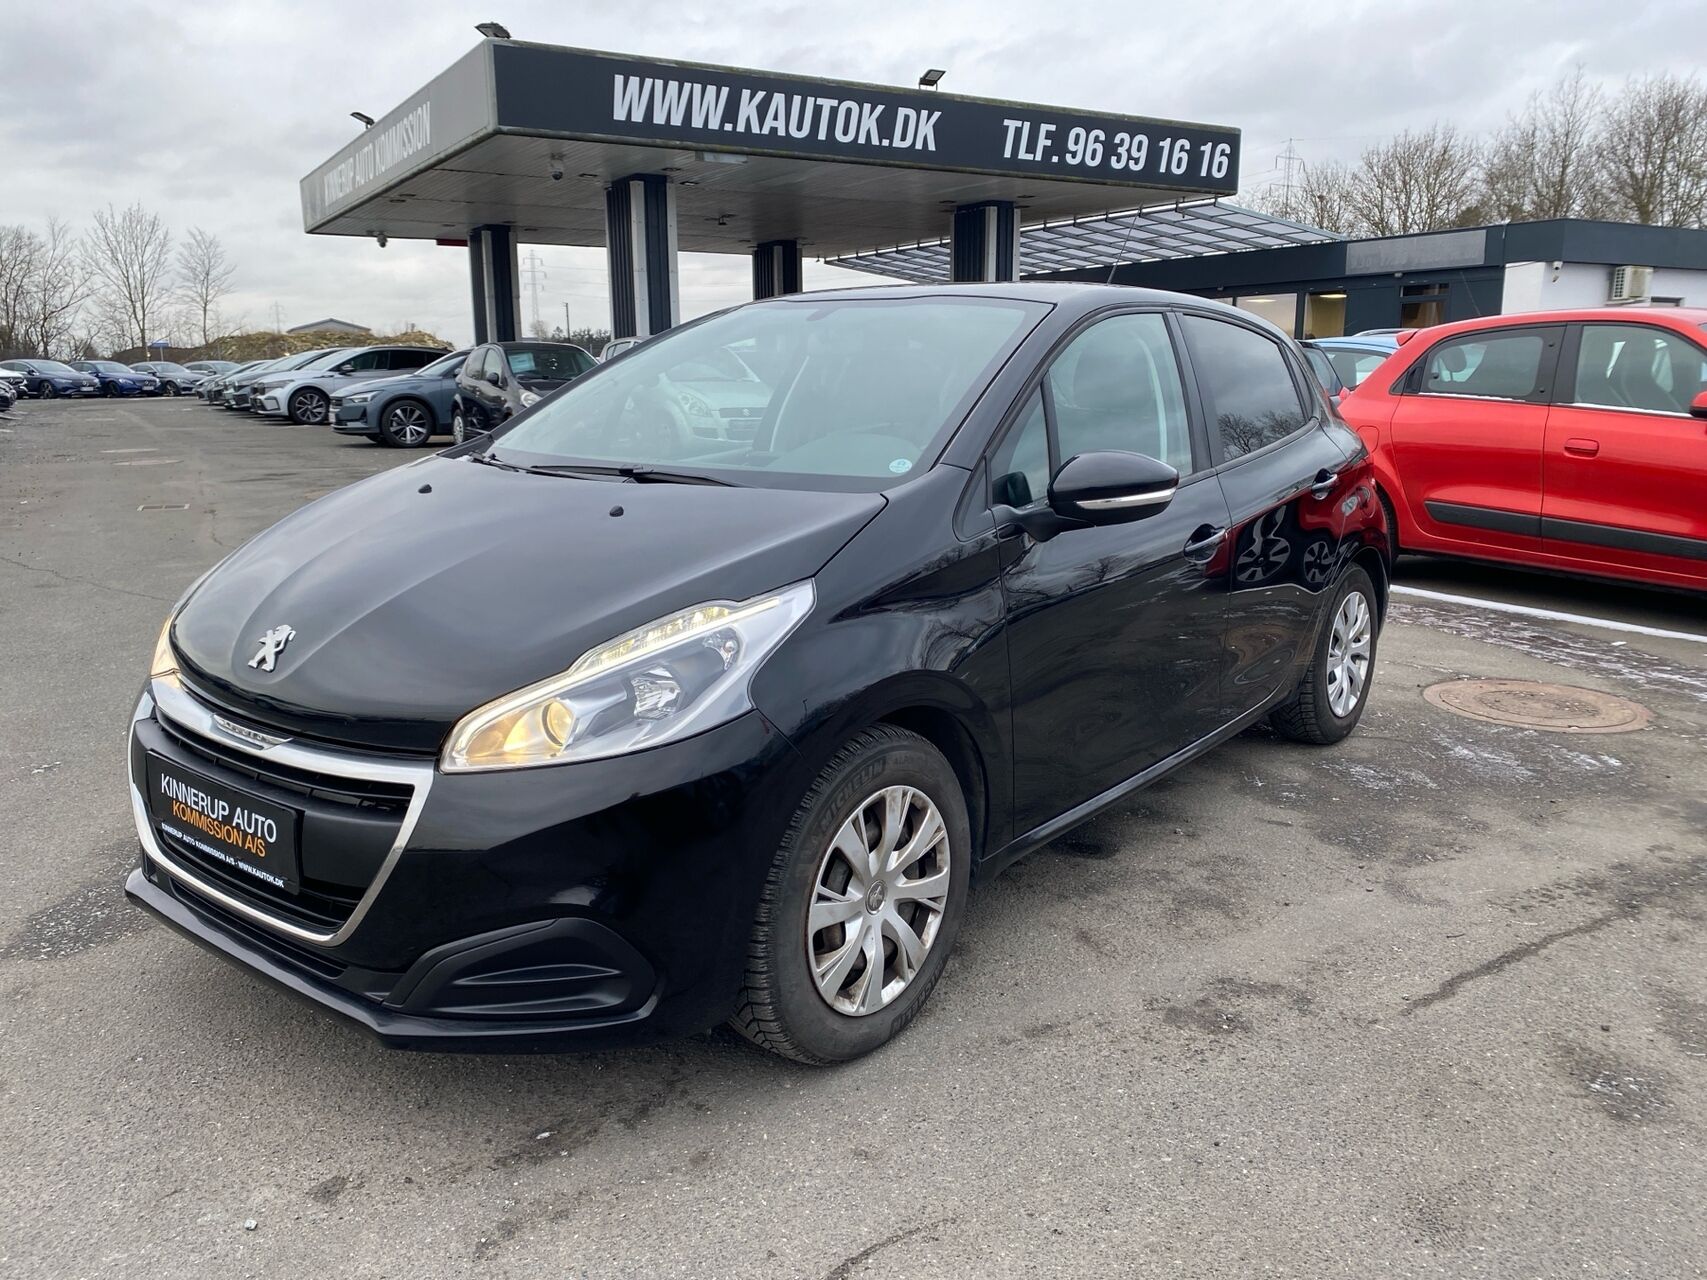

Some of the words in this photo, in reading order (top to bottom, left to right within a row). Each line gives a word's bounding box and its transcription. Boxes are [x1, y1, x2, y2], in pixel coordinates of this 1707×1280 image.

[613, 74, 942, 151] WWW.KAUTOK.DK
[1003, 119, 1058, 162] TLF.
[1065, 127, 1105, 167] 96
[1110, 132, 1149, 171] 39
[1158, 137, 1190, 175] 16
[1200, 142, 1231, 178] 16
[161, 773, 229, 821] KINNERUP
[233, 807, 276, 843] AUTO
[172, 800, 243, 847] KOMMISSION
[245, 832, 266, 857] A/S
